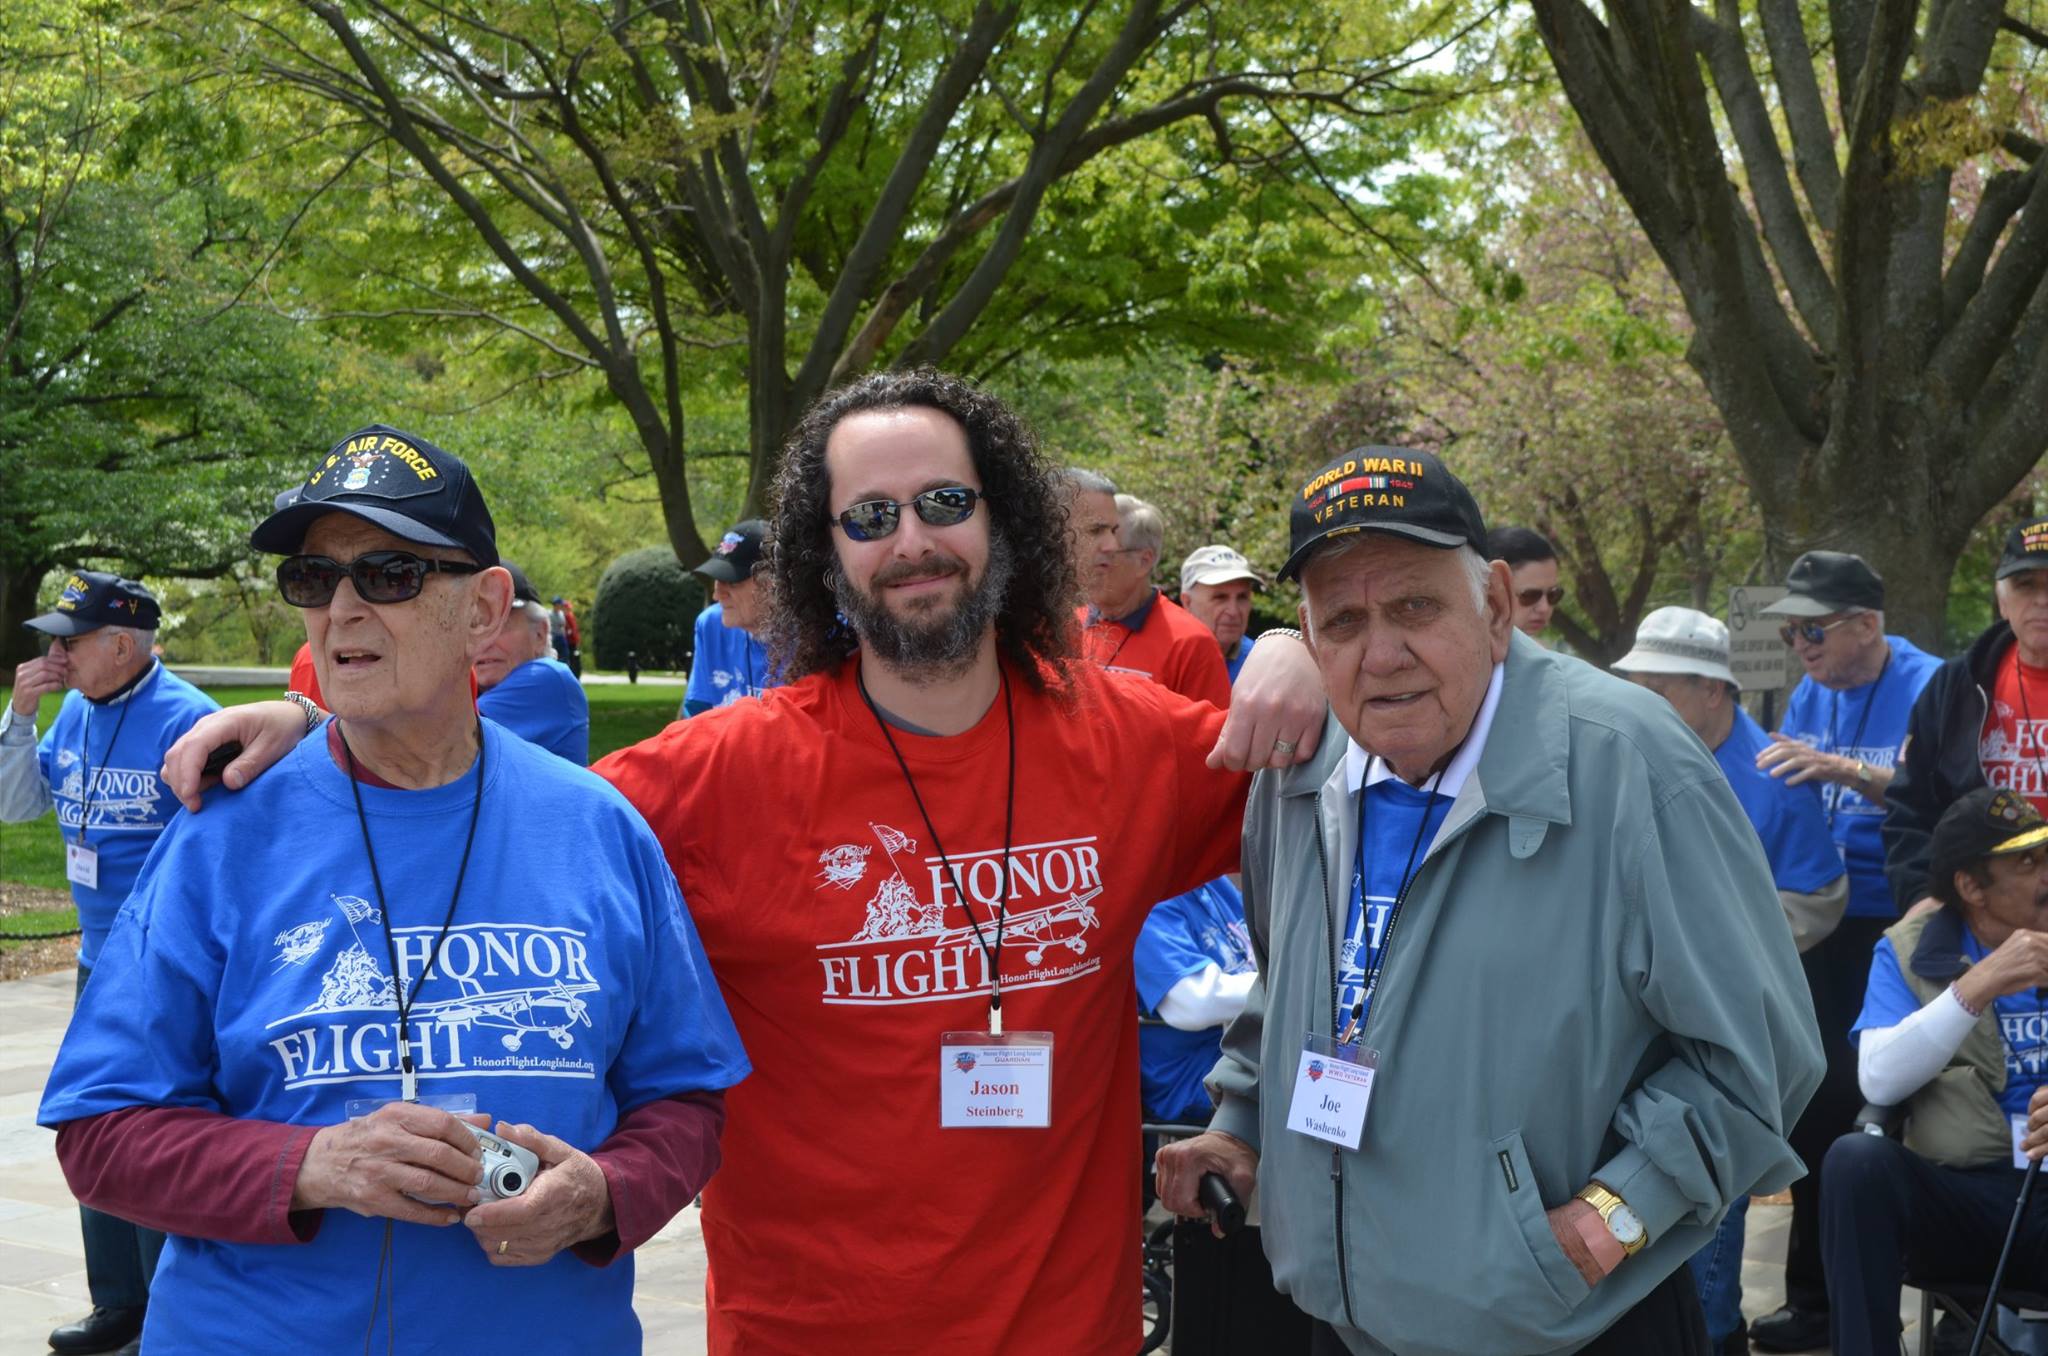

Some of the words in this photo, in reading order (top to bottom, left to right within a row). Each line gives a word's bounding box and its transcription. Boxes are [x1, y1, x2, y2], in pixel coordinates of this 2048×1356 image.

[345, 436, 379, 456] AIR
[380, 437, 438, 481] FORCE
[1303, 460, 1356, 500] WORLD
[1363, 458, 1406, 475] WAR
[1410, 462, 1424, 477] II
[1314, 493, 1405, 524] VETERAN
[2020, 522, 2048, 537] VIET
[927, 845, 1101, 908] HONOR
[391, 931, 598, 983] HONOR
[818, 945, 998, 998] FLIGHT
[999, 956, 1101, 984] HonorFlightLongIsland.org
[269, 1019, 472, 1081] FLIGHT
[970, 1080, 1020, 1096] Jason
[966, 1106, 1024, 1119] Steinberg
[1319, 1094, 1342, 1114] Joe
[1305, 1117, 1347, 1139] Washenko
